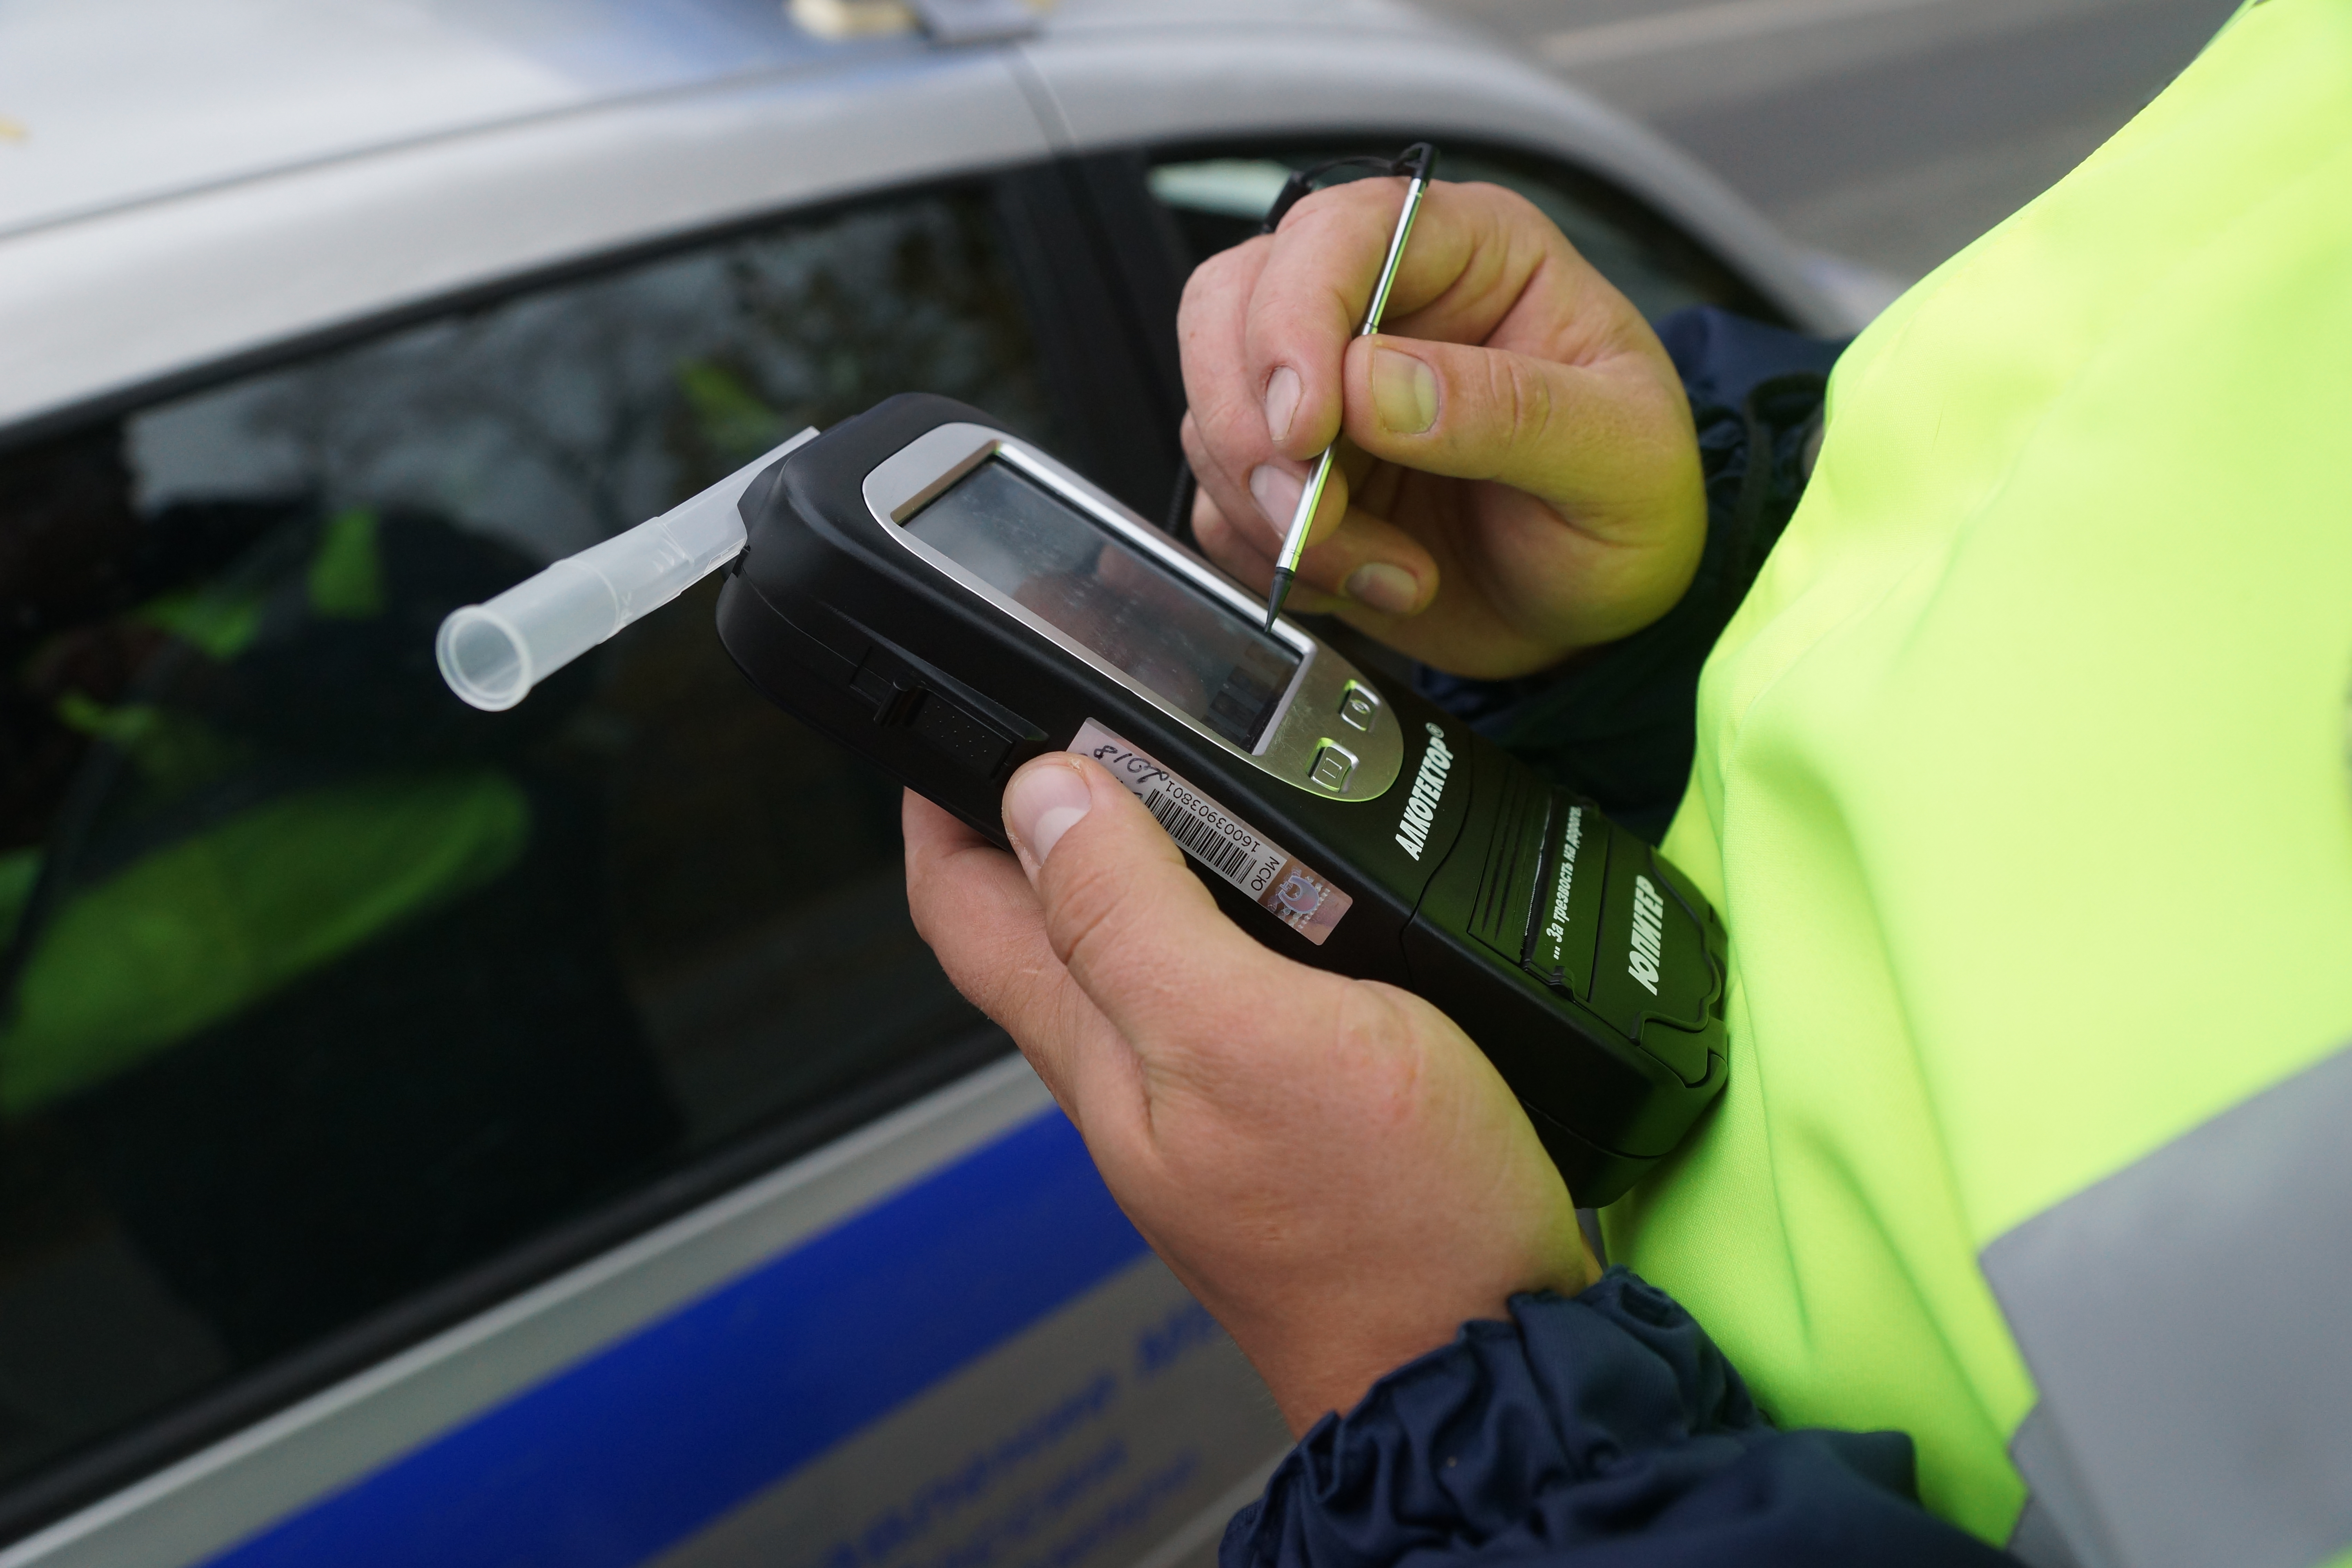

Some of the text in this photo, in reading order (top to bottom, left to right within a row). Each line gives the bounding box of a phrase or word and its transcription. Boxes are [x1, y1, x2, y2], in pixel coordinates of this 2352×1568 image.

[1167, 780, 1260, 853] 16003903801
[1251, 857, 1279, 892] МСЮ
[1563, 844, 1576, 862] на
[1553, 862, 1573, 923] трезвость
[1546, 923, 1564, 942] За
[1628, 875, 1663, 996] ЮПИТЕР
